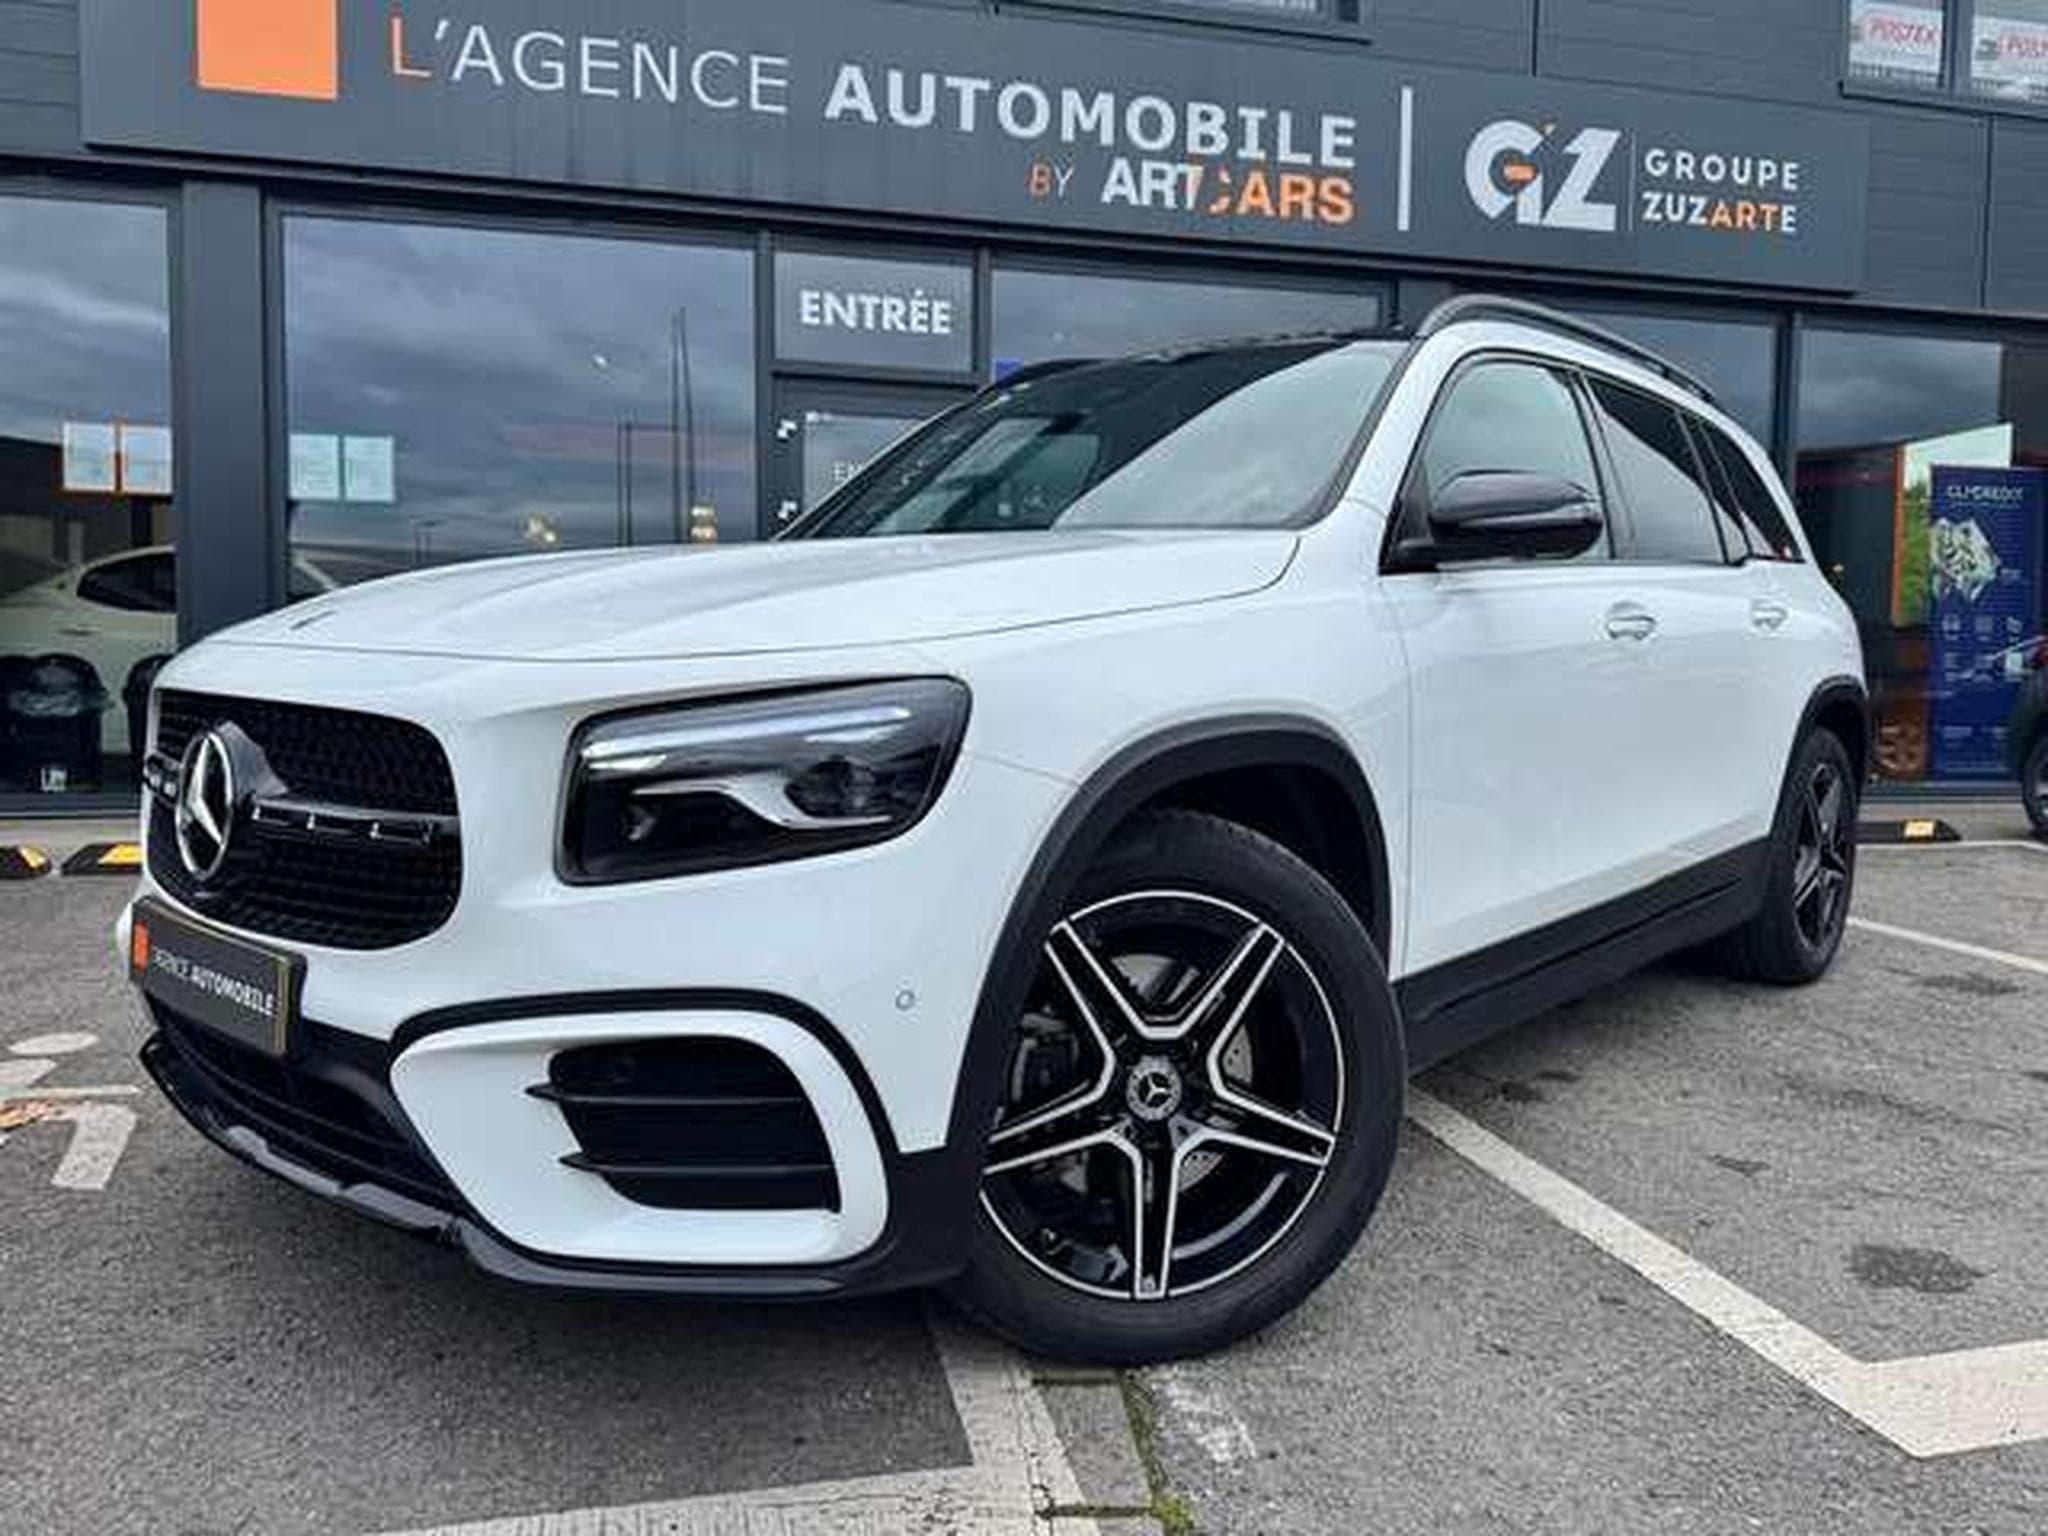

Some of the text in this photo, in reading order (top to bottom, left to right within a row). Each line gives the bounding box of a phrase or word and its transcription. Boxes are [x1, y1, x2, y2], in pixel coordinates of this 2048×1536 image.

[387, 13, 1357, 169] L'AGENCE AUTOMOBILE
[1028, 161, 1076, 199] BY
[1643, 148, 1800, 191] GROUPE
[1641, 191, 1799, 233] ZUZARTE
[800, 288, 952, 335] ENTRÉE
[191, 964, 275, 1017] AUTOMOBILE
